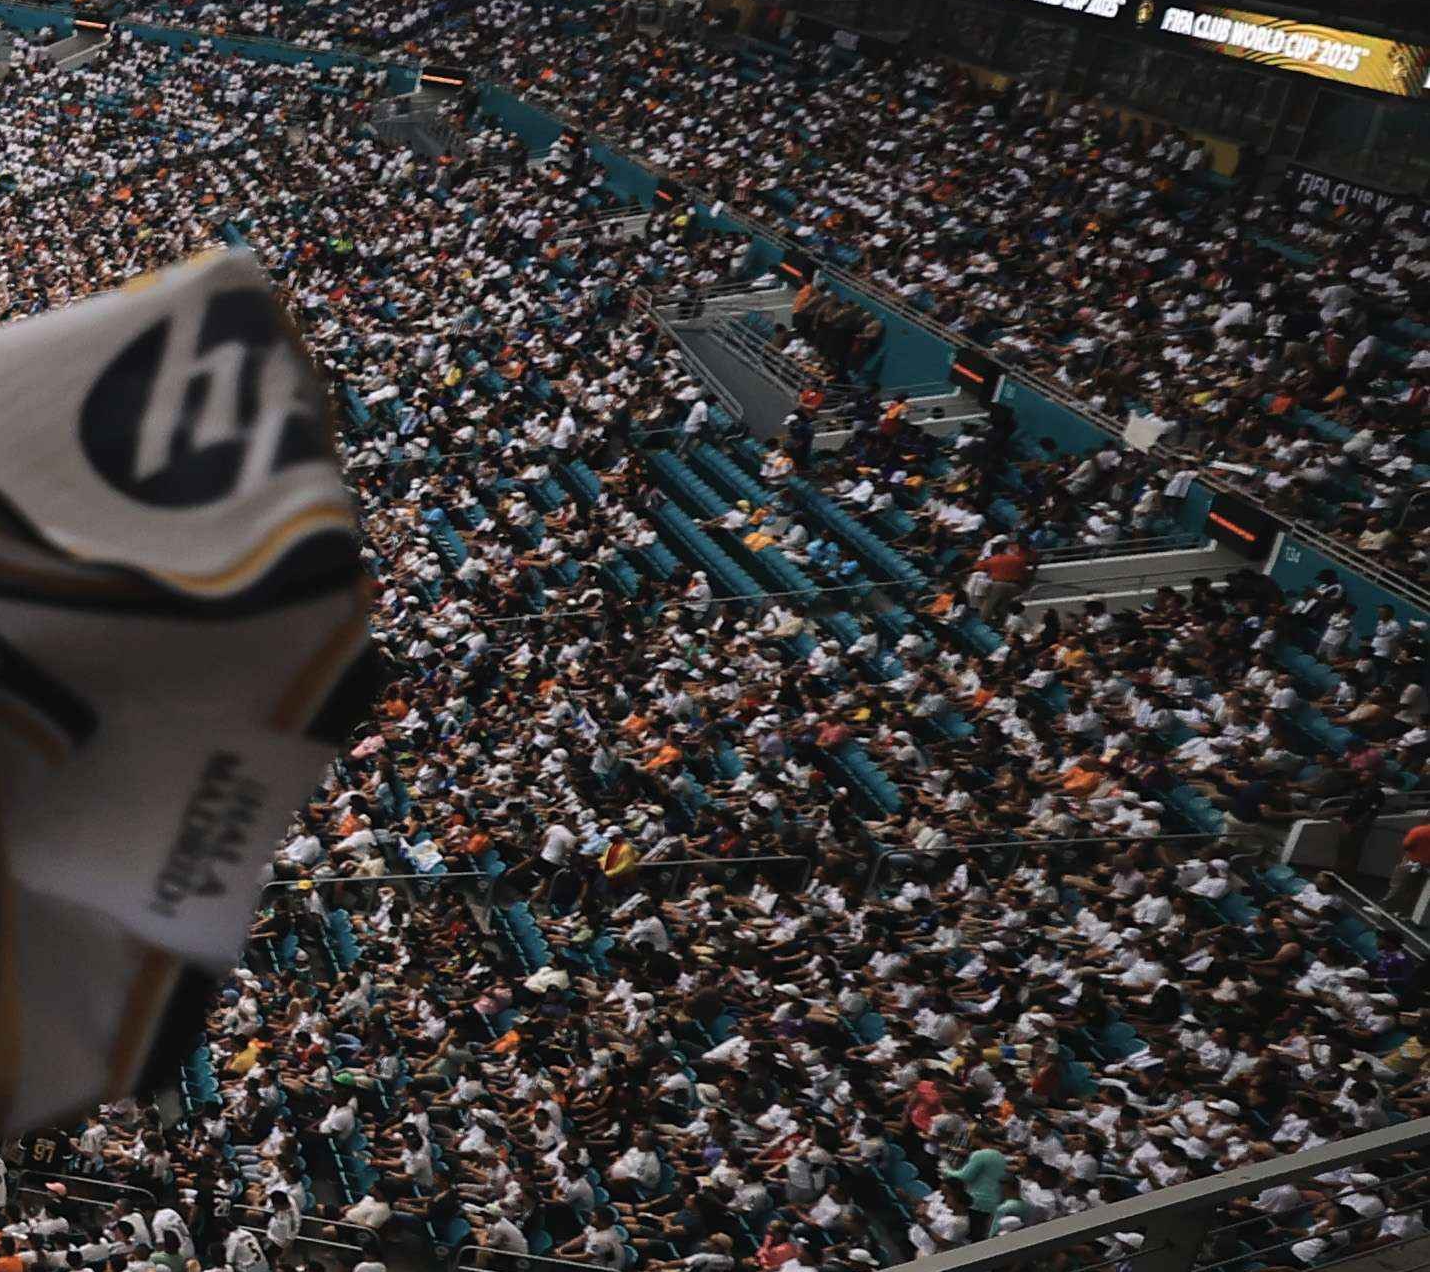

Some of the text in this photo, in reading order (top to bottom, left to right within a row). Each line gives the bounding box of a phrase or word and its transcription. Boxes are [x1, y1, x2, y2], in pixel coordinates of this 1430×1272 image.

[1160, 6, 1195, 37] FIFA
[1192, 13, 1233, 43] CLUB
[1227, 19, 1286, 54] WORLD
[1282, 33, 1320, 62] CUP
